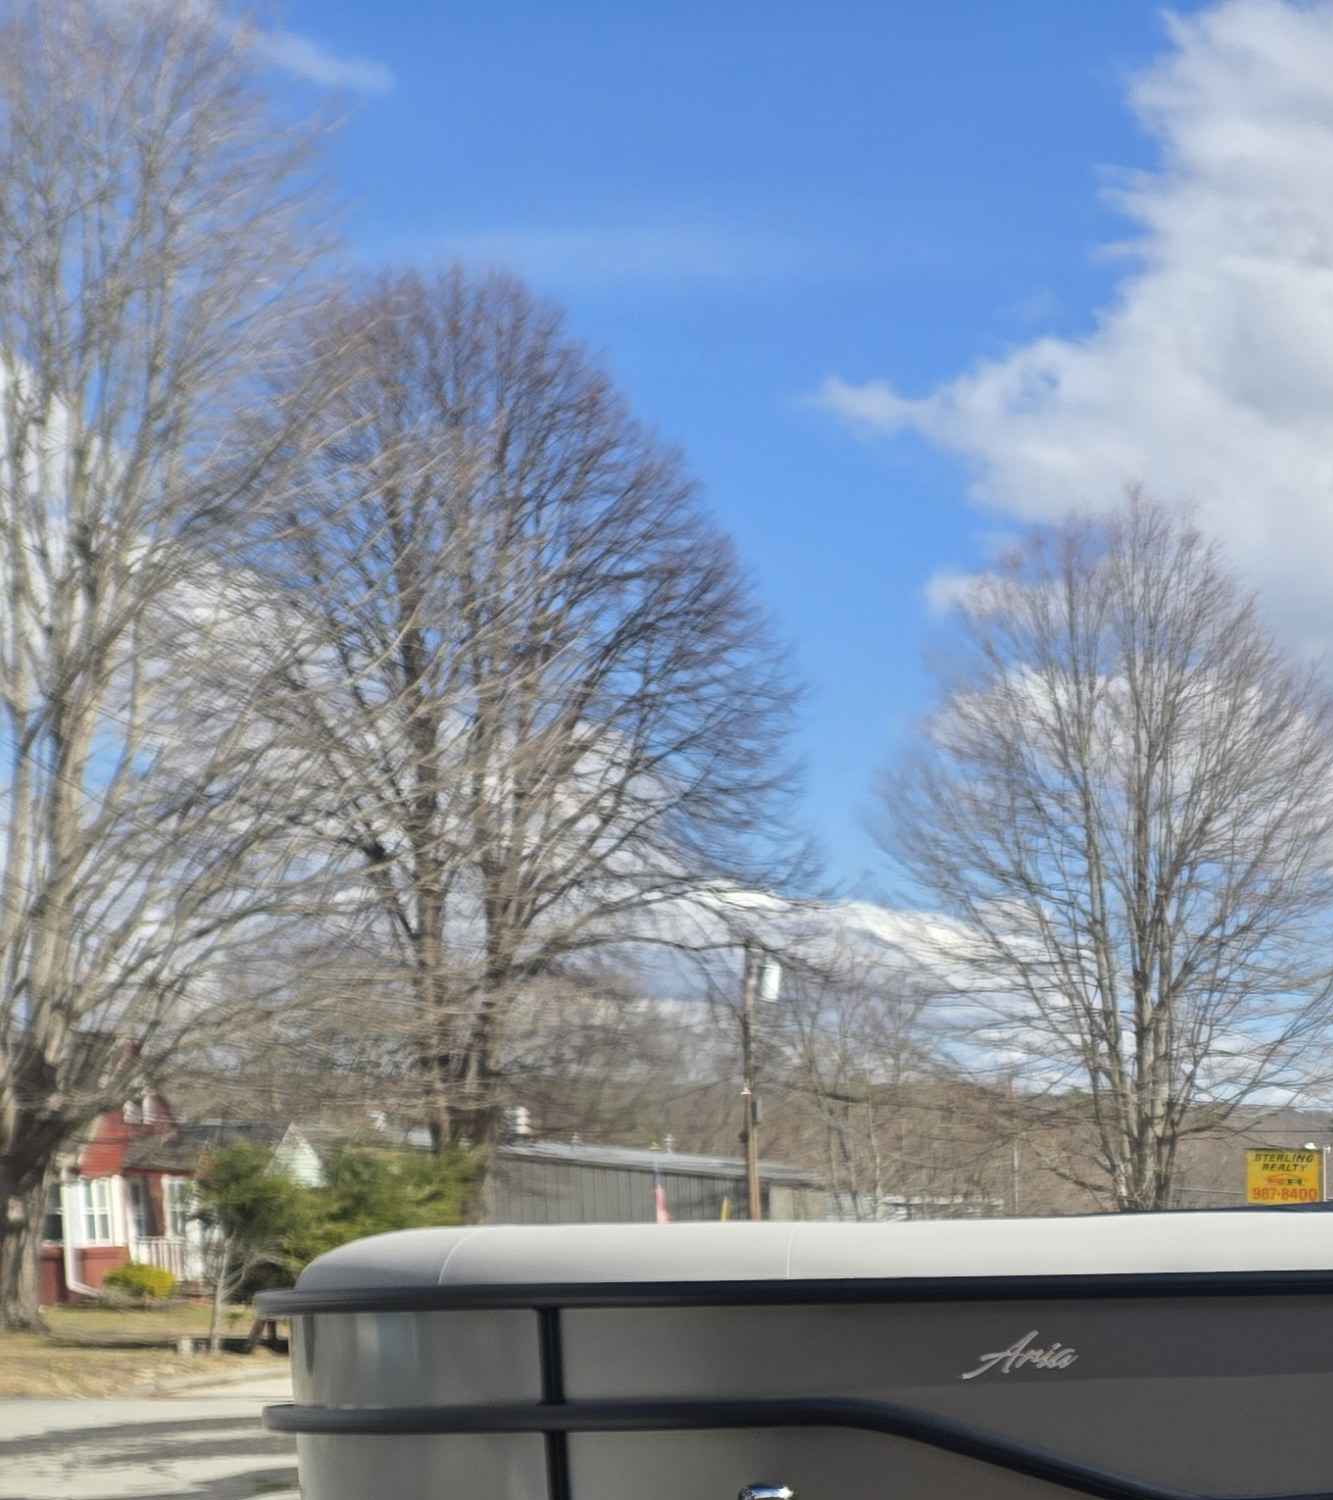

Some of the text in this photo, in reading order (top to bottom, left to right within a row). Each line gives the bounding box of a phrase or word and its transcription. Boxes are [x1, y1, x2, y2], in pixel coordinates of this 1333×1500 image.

[1254, 1153, 1314, 1163] STERLING
[1262, 1163, 1309, 1173] REALTY
[961, 1329, 1080, 1380] Aria
